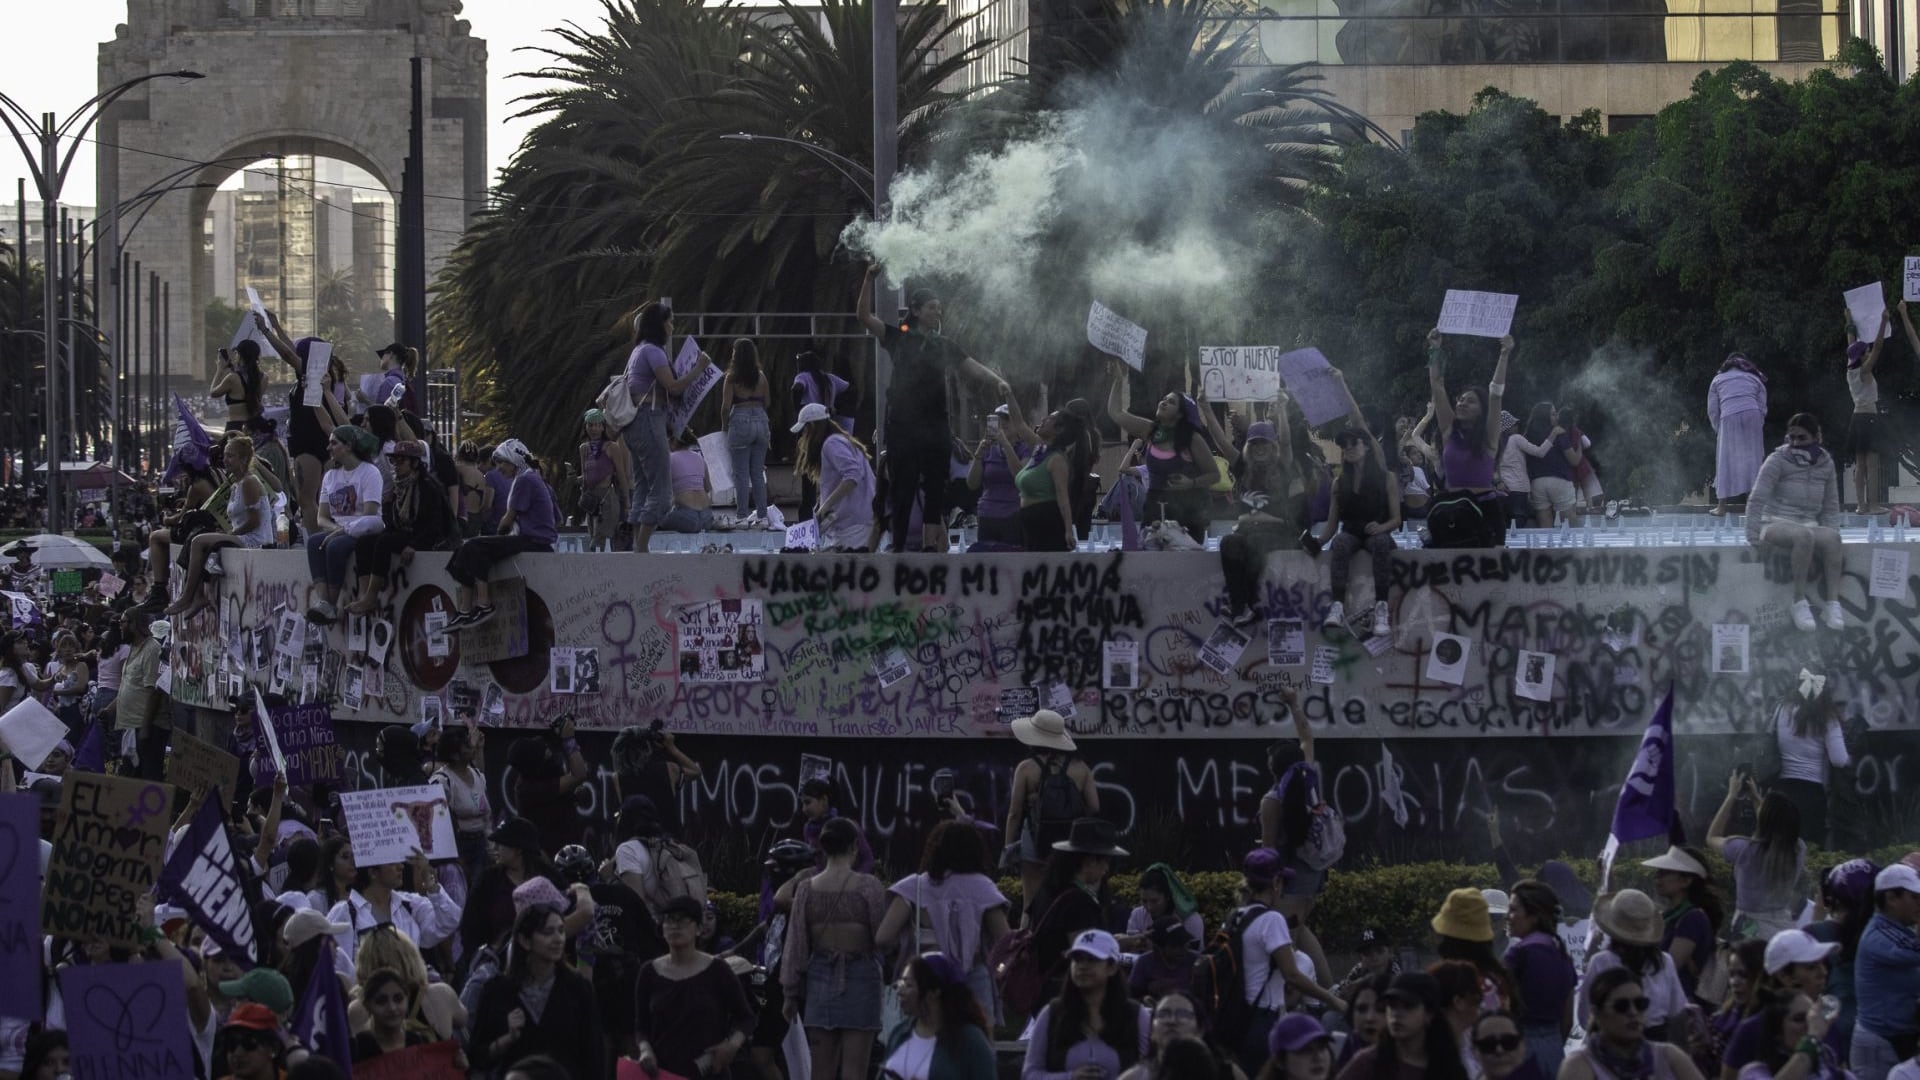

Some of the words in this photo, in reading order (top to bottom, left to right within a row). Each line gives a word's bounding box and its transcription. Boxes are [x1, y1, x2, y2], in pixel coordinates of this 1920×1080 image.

[1200, 348, 1228, 367] ESTOY
[893, 564, 948, 595] POR
[960, 565, 998, 596] MI
[1303, 686, 1367, 728] de
